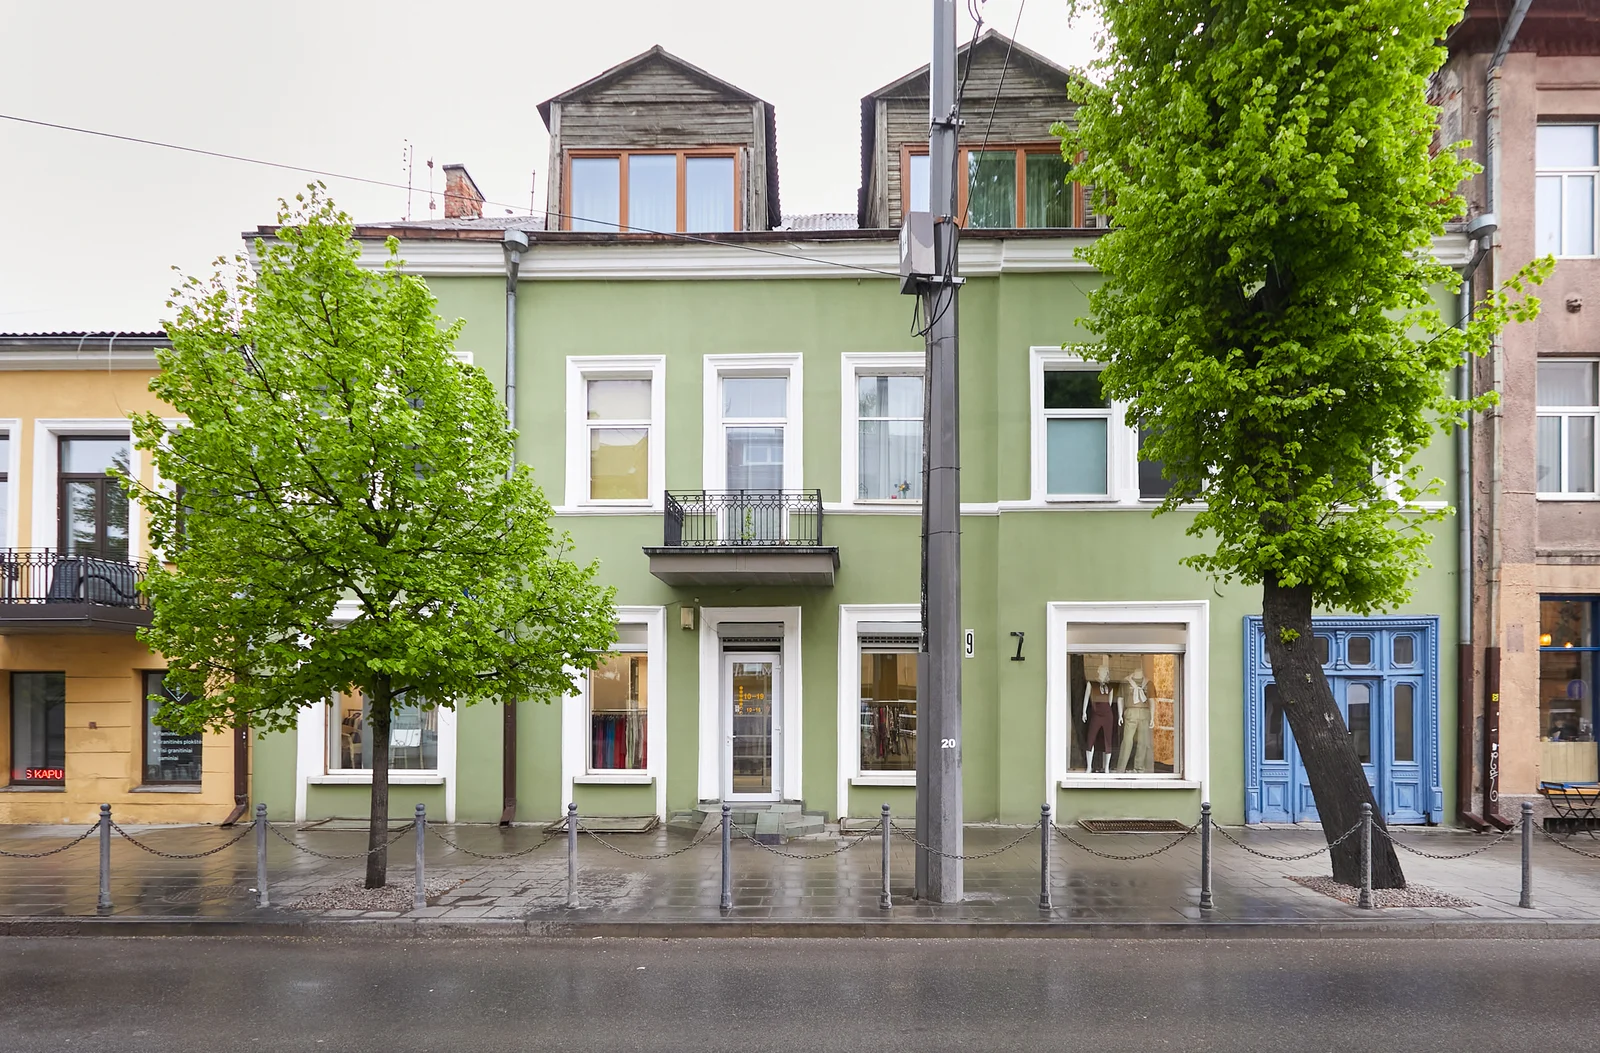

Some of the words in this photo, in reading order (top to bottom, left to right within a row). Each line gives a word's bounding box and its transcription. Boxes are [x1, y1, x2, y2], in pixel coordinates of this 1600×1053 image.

[966, 632, 973, 655] 9
[941, 738, 956, 749] 20
[34, 769, 63, 780] KAPU
